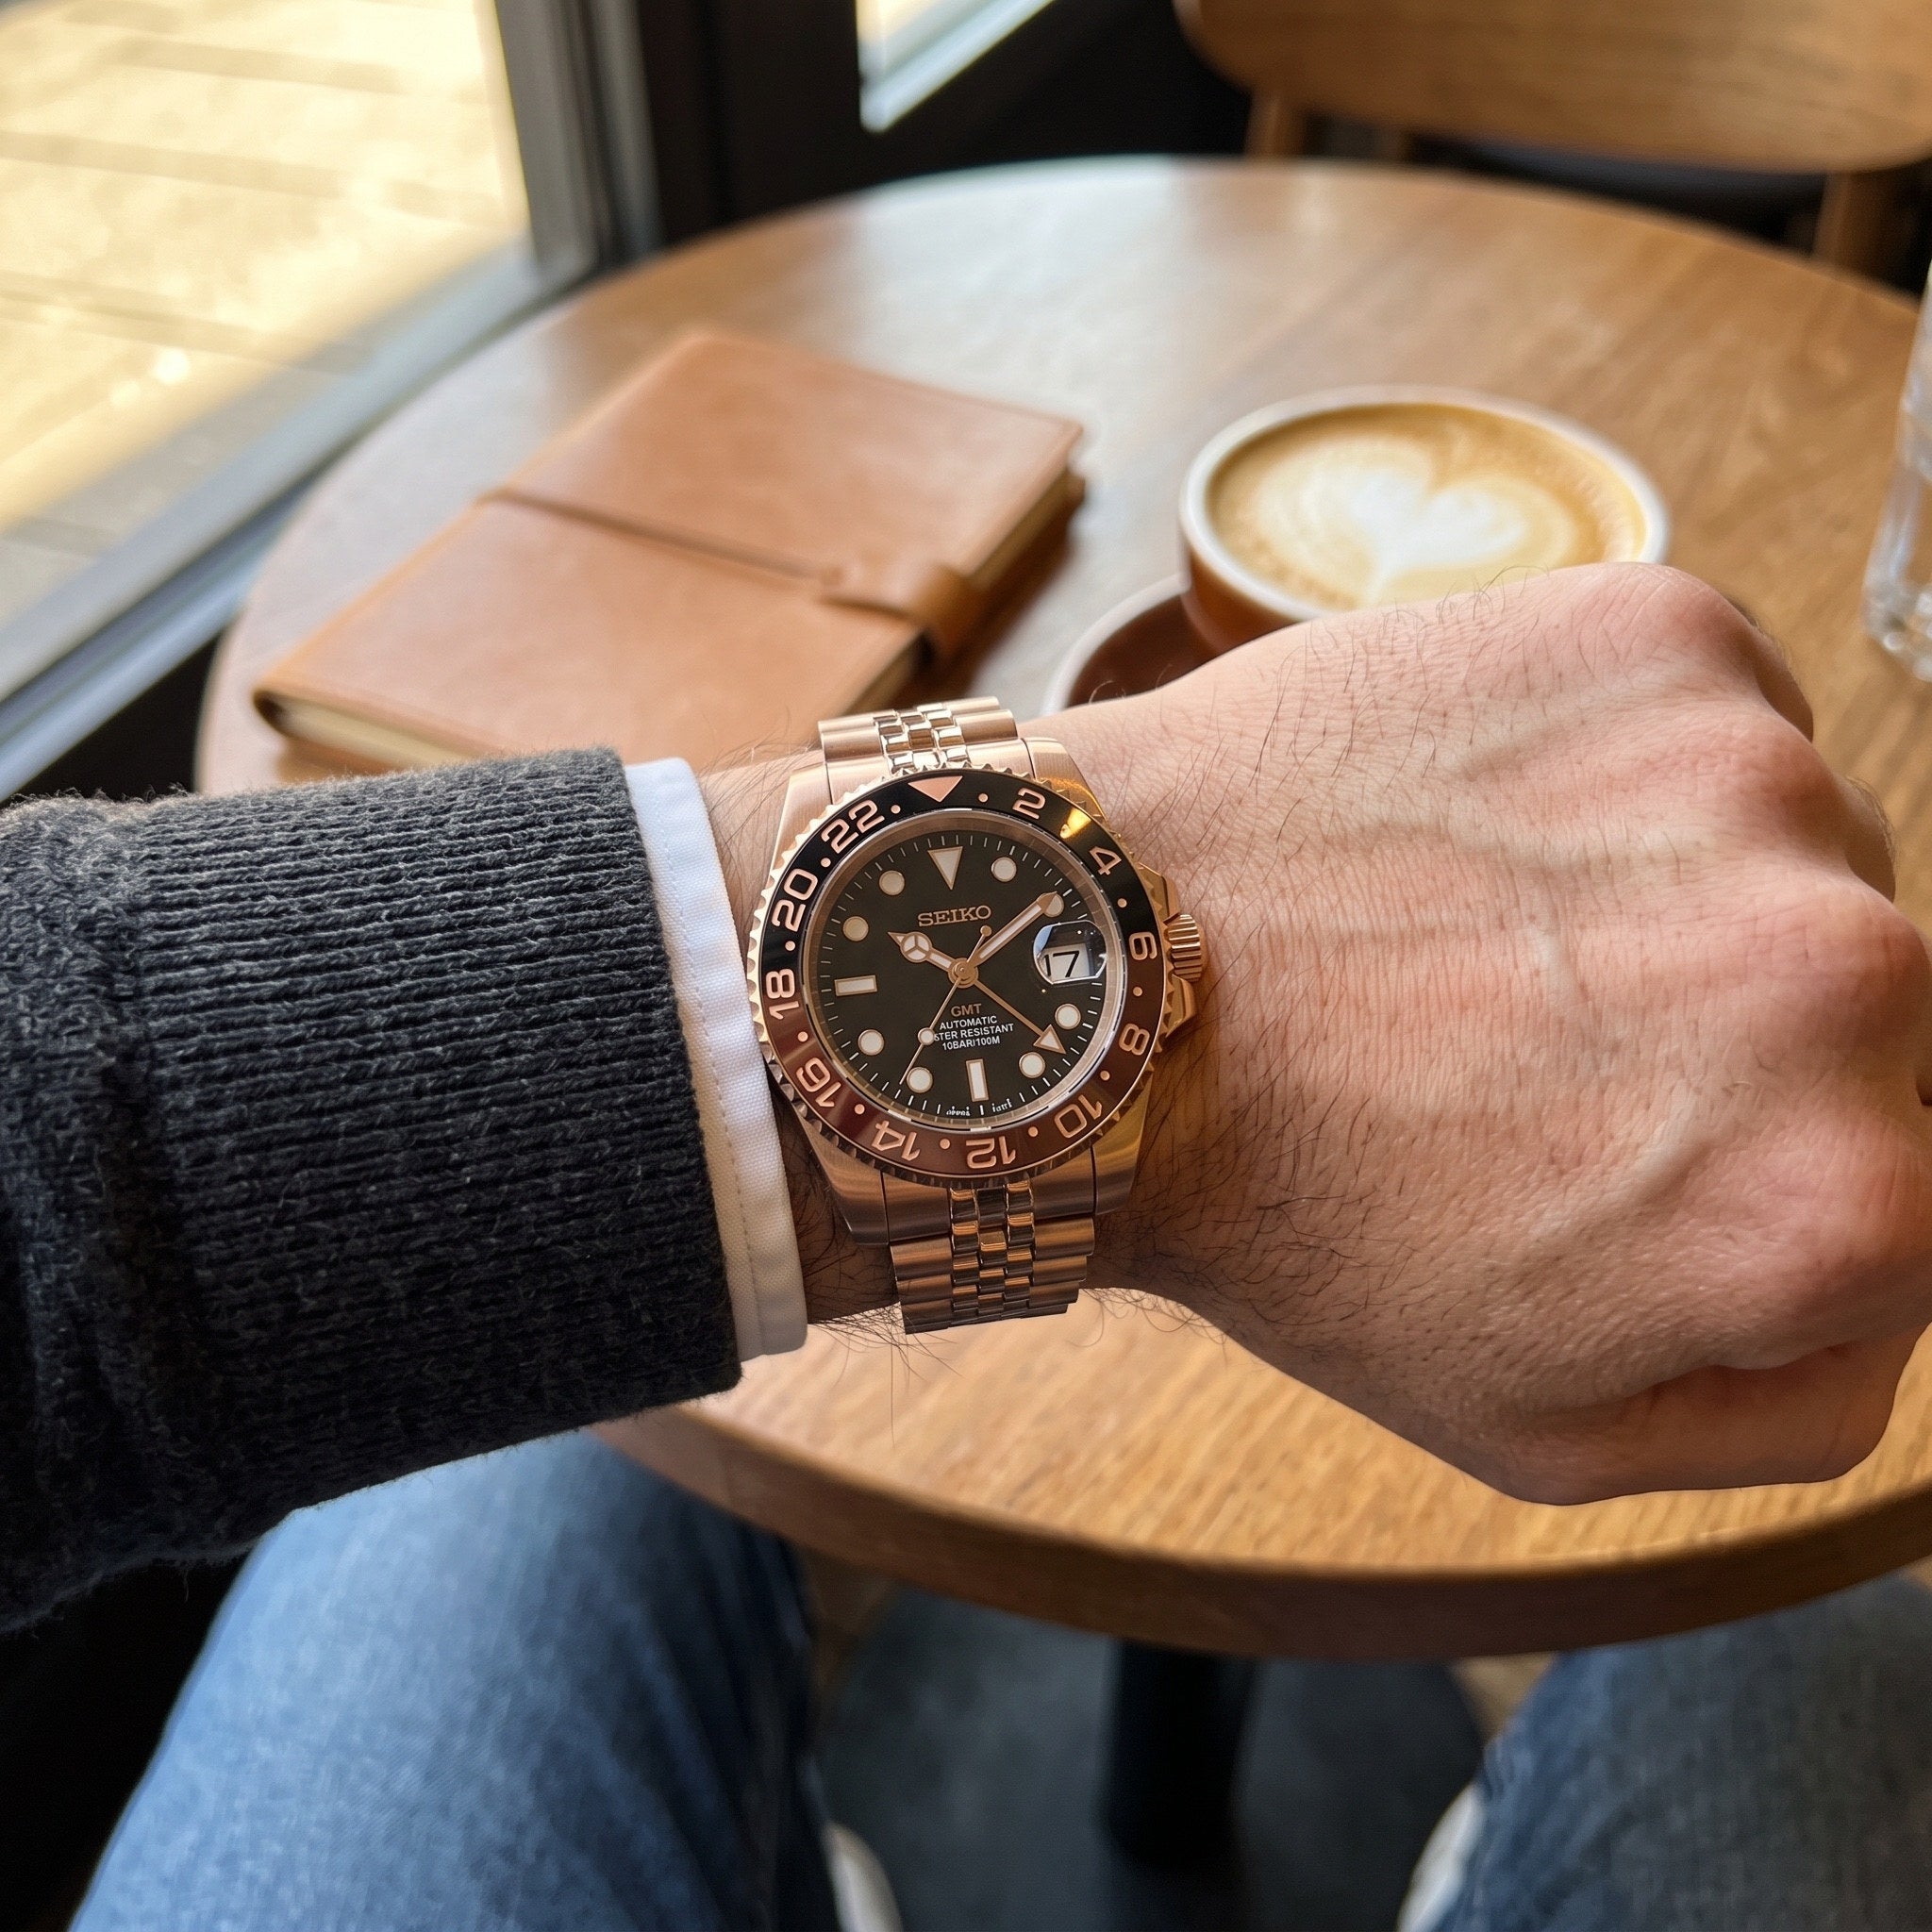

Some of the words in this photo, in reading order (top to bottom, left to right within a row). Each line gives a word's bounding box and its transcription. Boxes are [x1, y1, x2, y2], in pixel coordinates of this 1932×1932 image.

[1012, 787, 1045, 819] 2
[821, 799, 885, 854] 22
[1090, 846, 1122, 875] 4
[772, 868, 819, 932] 20
[918, 905, 991, 927] SEIKO
[1128, 931, 1158, 961] 6
[1043, 950, 1080, 978] 17
[765, 969, 800, 1020] 18
[950, 1003, 982, 1017] GMT
[940, 1015, 998, 1031] AUTOMATIC
[959, 1023, 1015, 1039] RESISTANT
[941, 1036, 1001, 1051] 10BAR/100M
[1119, 1024, 1149, 1055] 8
[796, 1058, 842, 1109] 16
[1054, 1094, 1103, 1139] 10
[871, 1120, 922, 1162] 14
[964, 1136, 1017, 1170] 12
